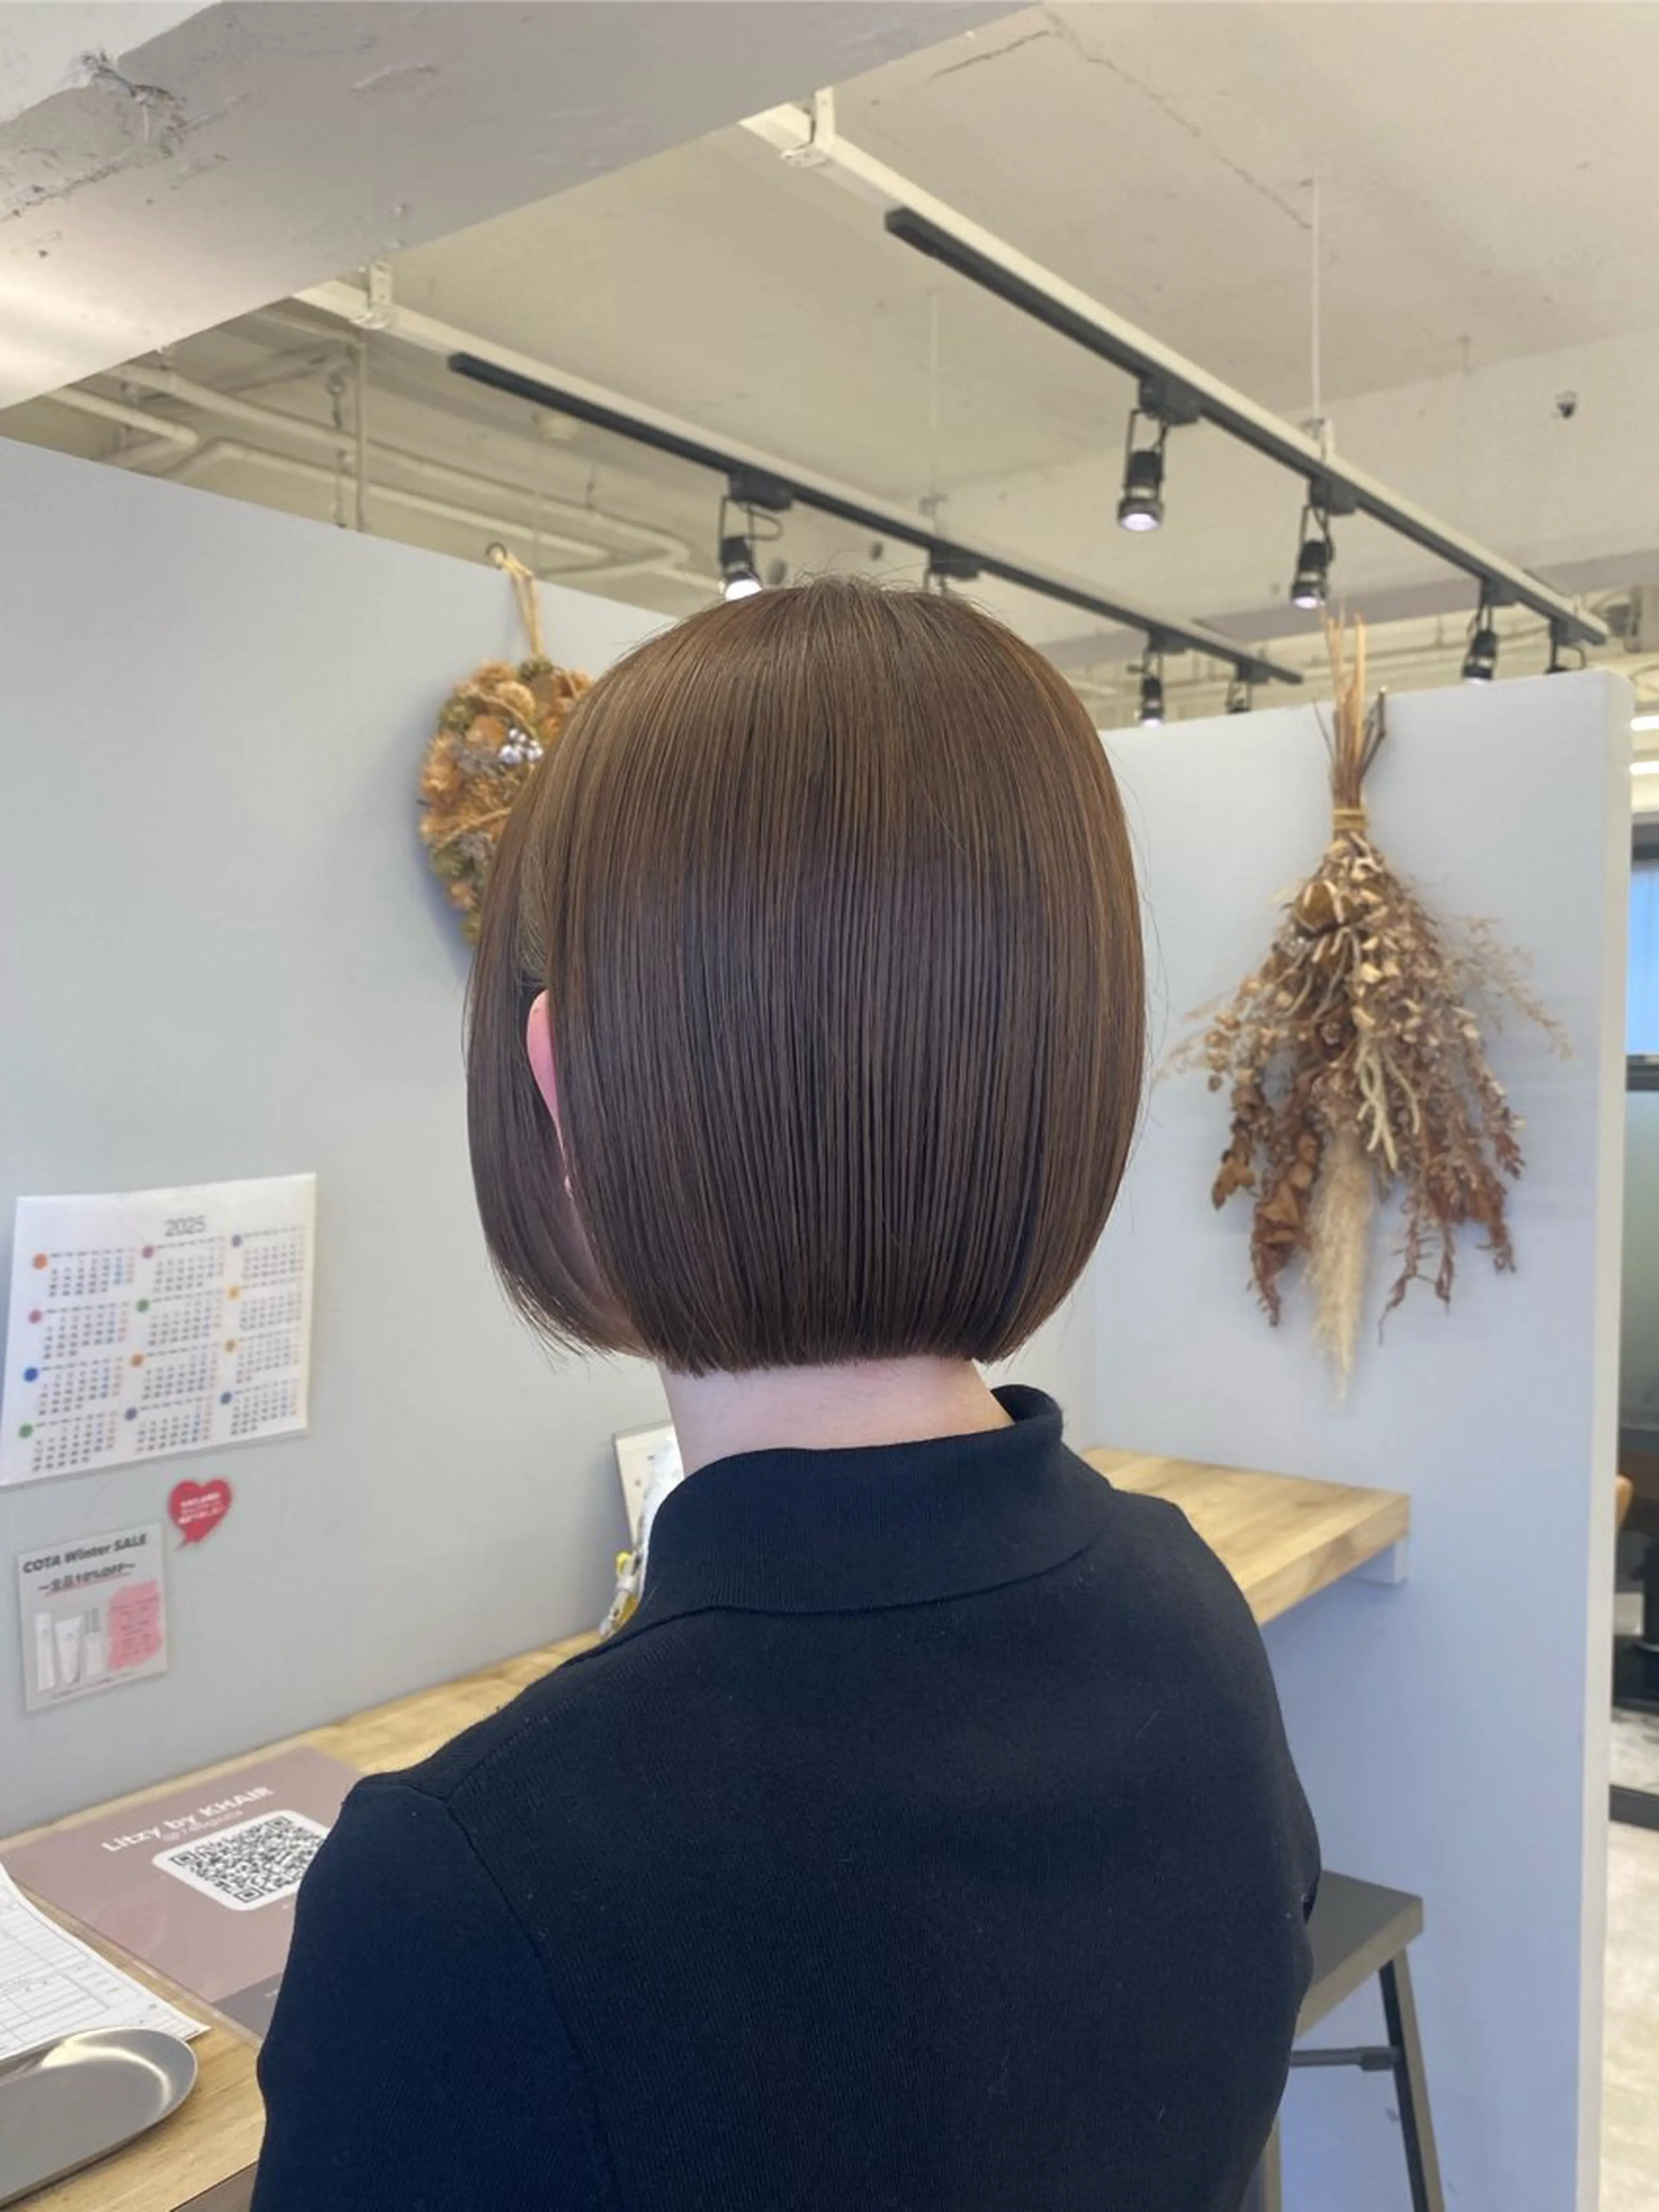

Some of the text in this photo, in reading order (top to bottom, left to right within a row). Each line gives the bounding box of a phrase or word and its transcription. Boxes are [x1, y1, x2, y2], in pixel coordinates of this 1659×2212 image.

[164, 1215, 207, 1237] 2025
[23, 1533, 147, 1573] COTA Winter SALE
[162, 1814, 196, 1830] by
[197, 1786, 274, 1816] KHAIR
